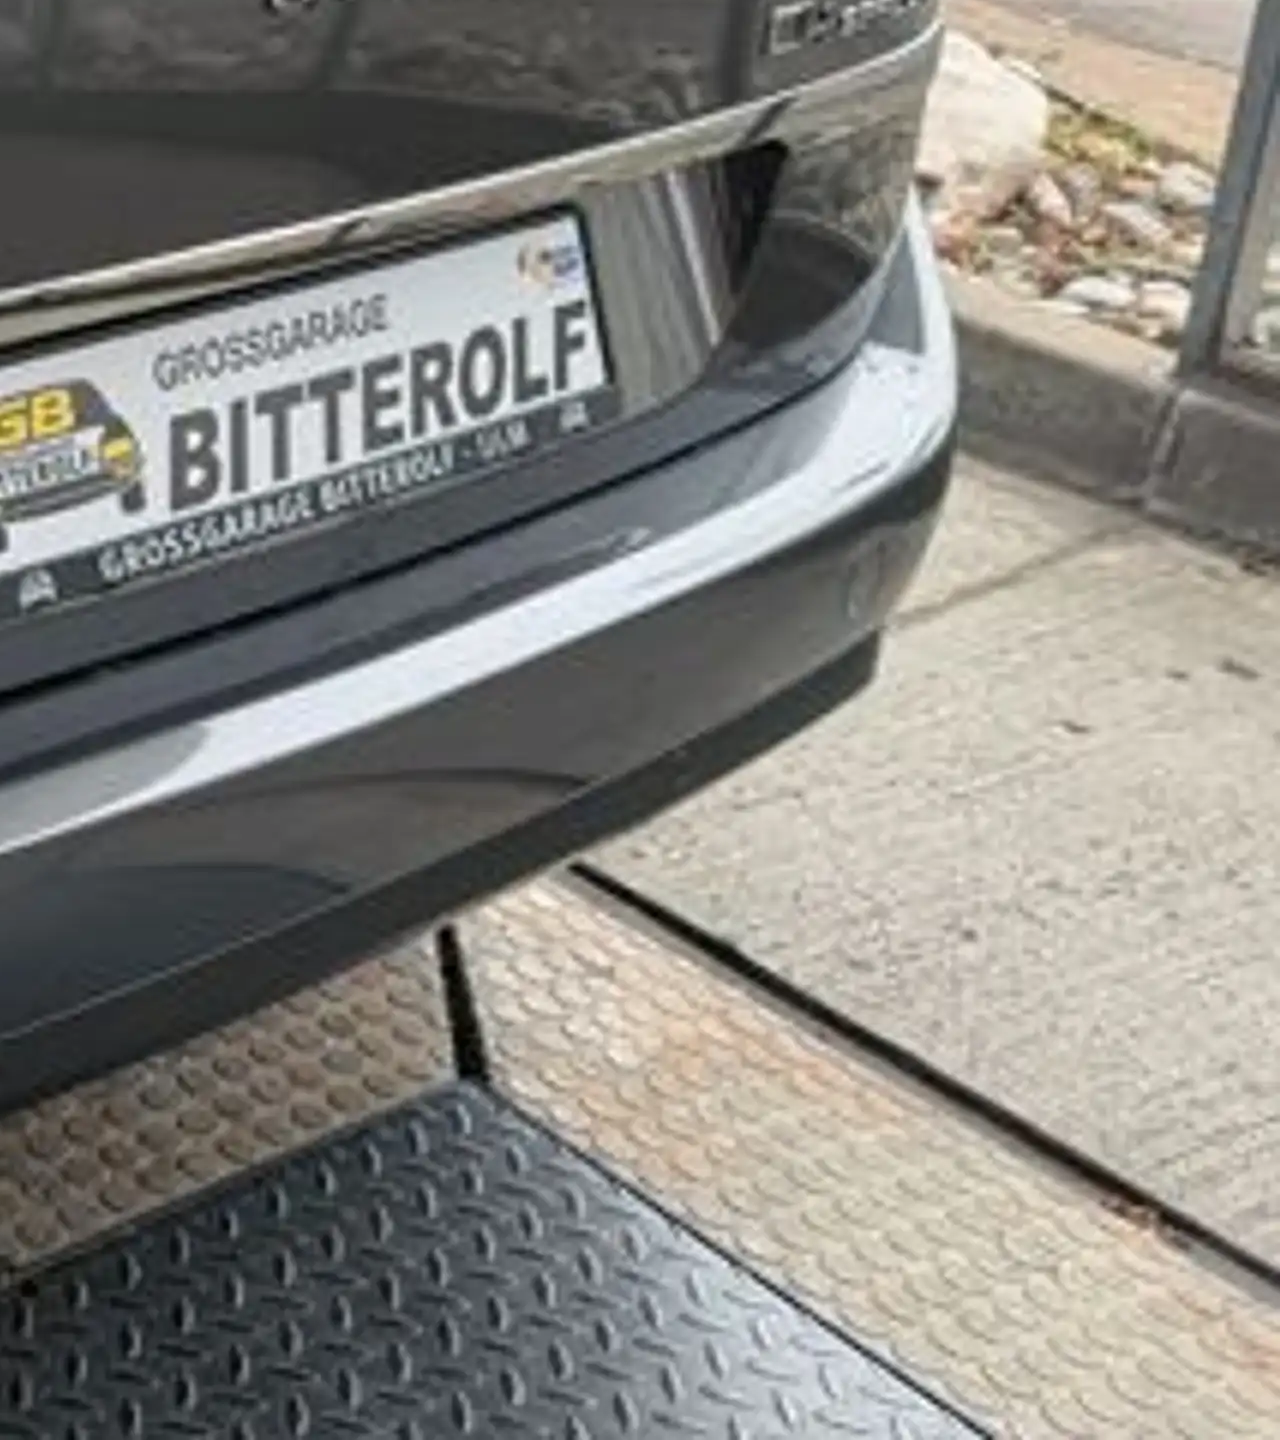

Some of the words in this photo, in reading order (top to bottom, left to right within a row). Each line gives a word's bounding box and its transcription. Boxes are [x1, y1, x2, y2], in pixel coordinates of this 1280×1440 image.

[151, 293, 391, 391] GROSSGARAGE
[170, 300, 588, 511] BITTEROLF
[96, 491, 313, 582] GROSSGARAGE
[320, 445, 456, 513] BITTEROLF
